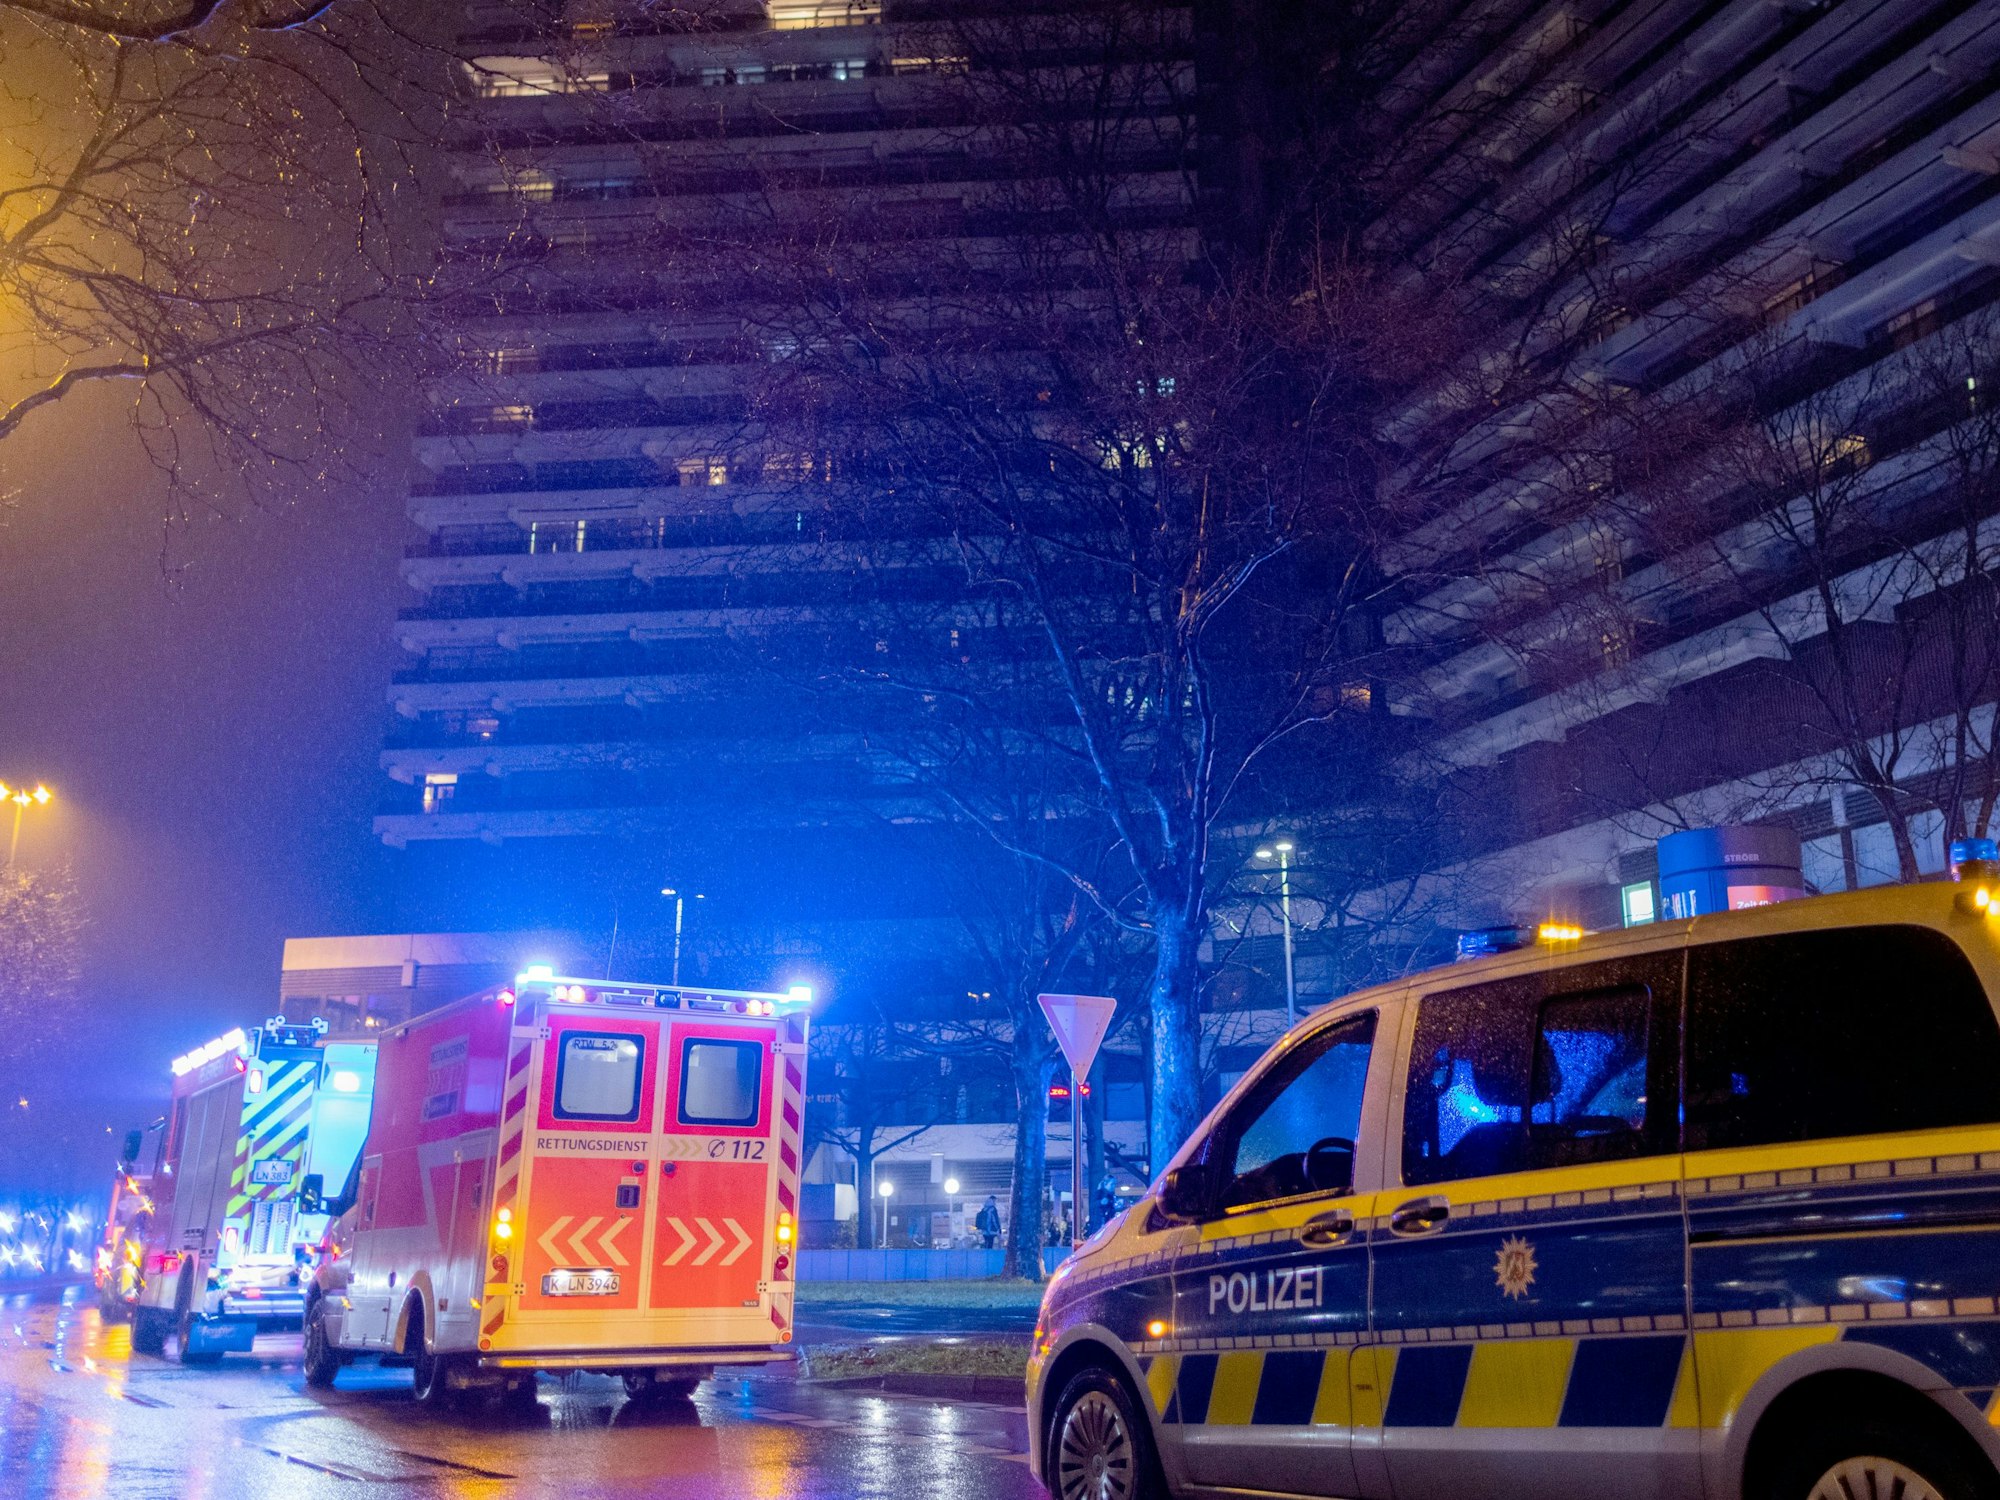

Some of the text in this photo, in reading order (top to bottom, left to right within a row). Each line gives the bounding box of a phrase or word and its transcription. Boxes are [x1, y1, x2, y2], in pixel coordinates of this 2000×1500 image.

[537, 1137, 648, 1152] RETTUNGSDIENST
[732, 1139, 765, 1160] 112
[271, 1162, 278, 1171] K
[255, 1171, 288, 1181] LN 383
[551, 1277, 618, 1291] K LN 3946
[1209, 1265, 1323, 1315] POLIZEI
